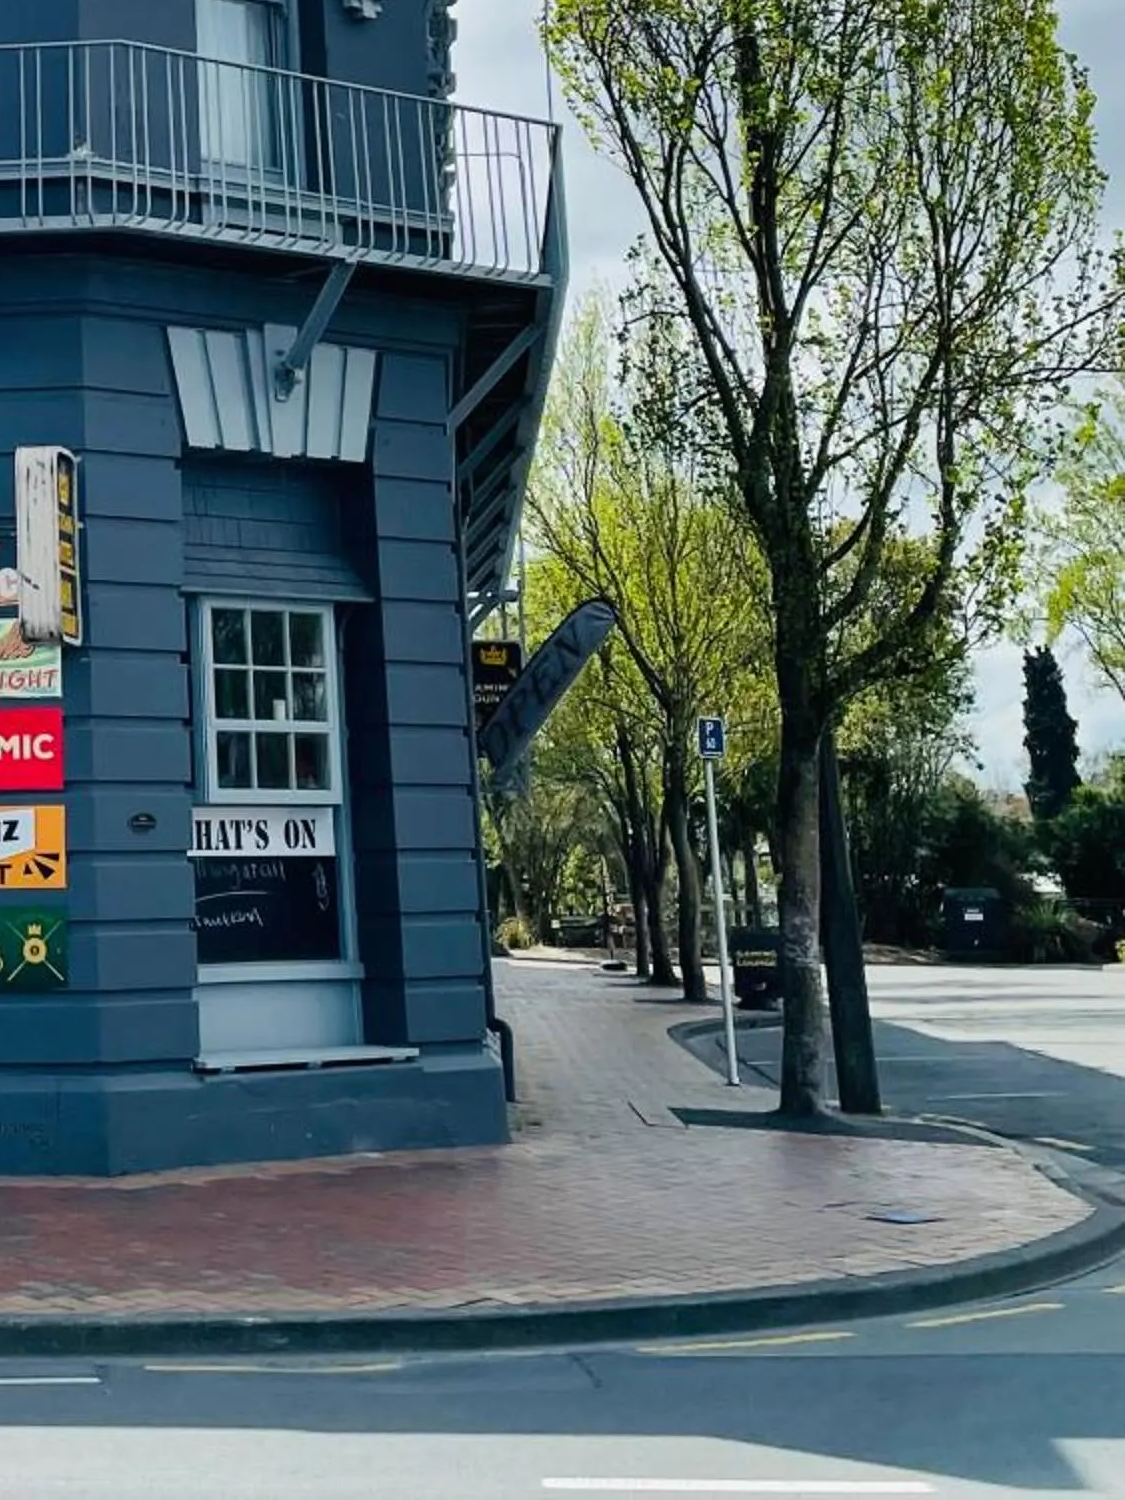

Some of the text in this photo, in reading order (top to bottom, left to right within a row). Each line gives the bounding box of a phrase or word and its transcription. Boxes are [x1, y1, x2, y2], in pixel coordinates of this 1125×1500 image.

[705, 721, 714, 736] P
[195, 819, 316, 851] HAT'S ON
